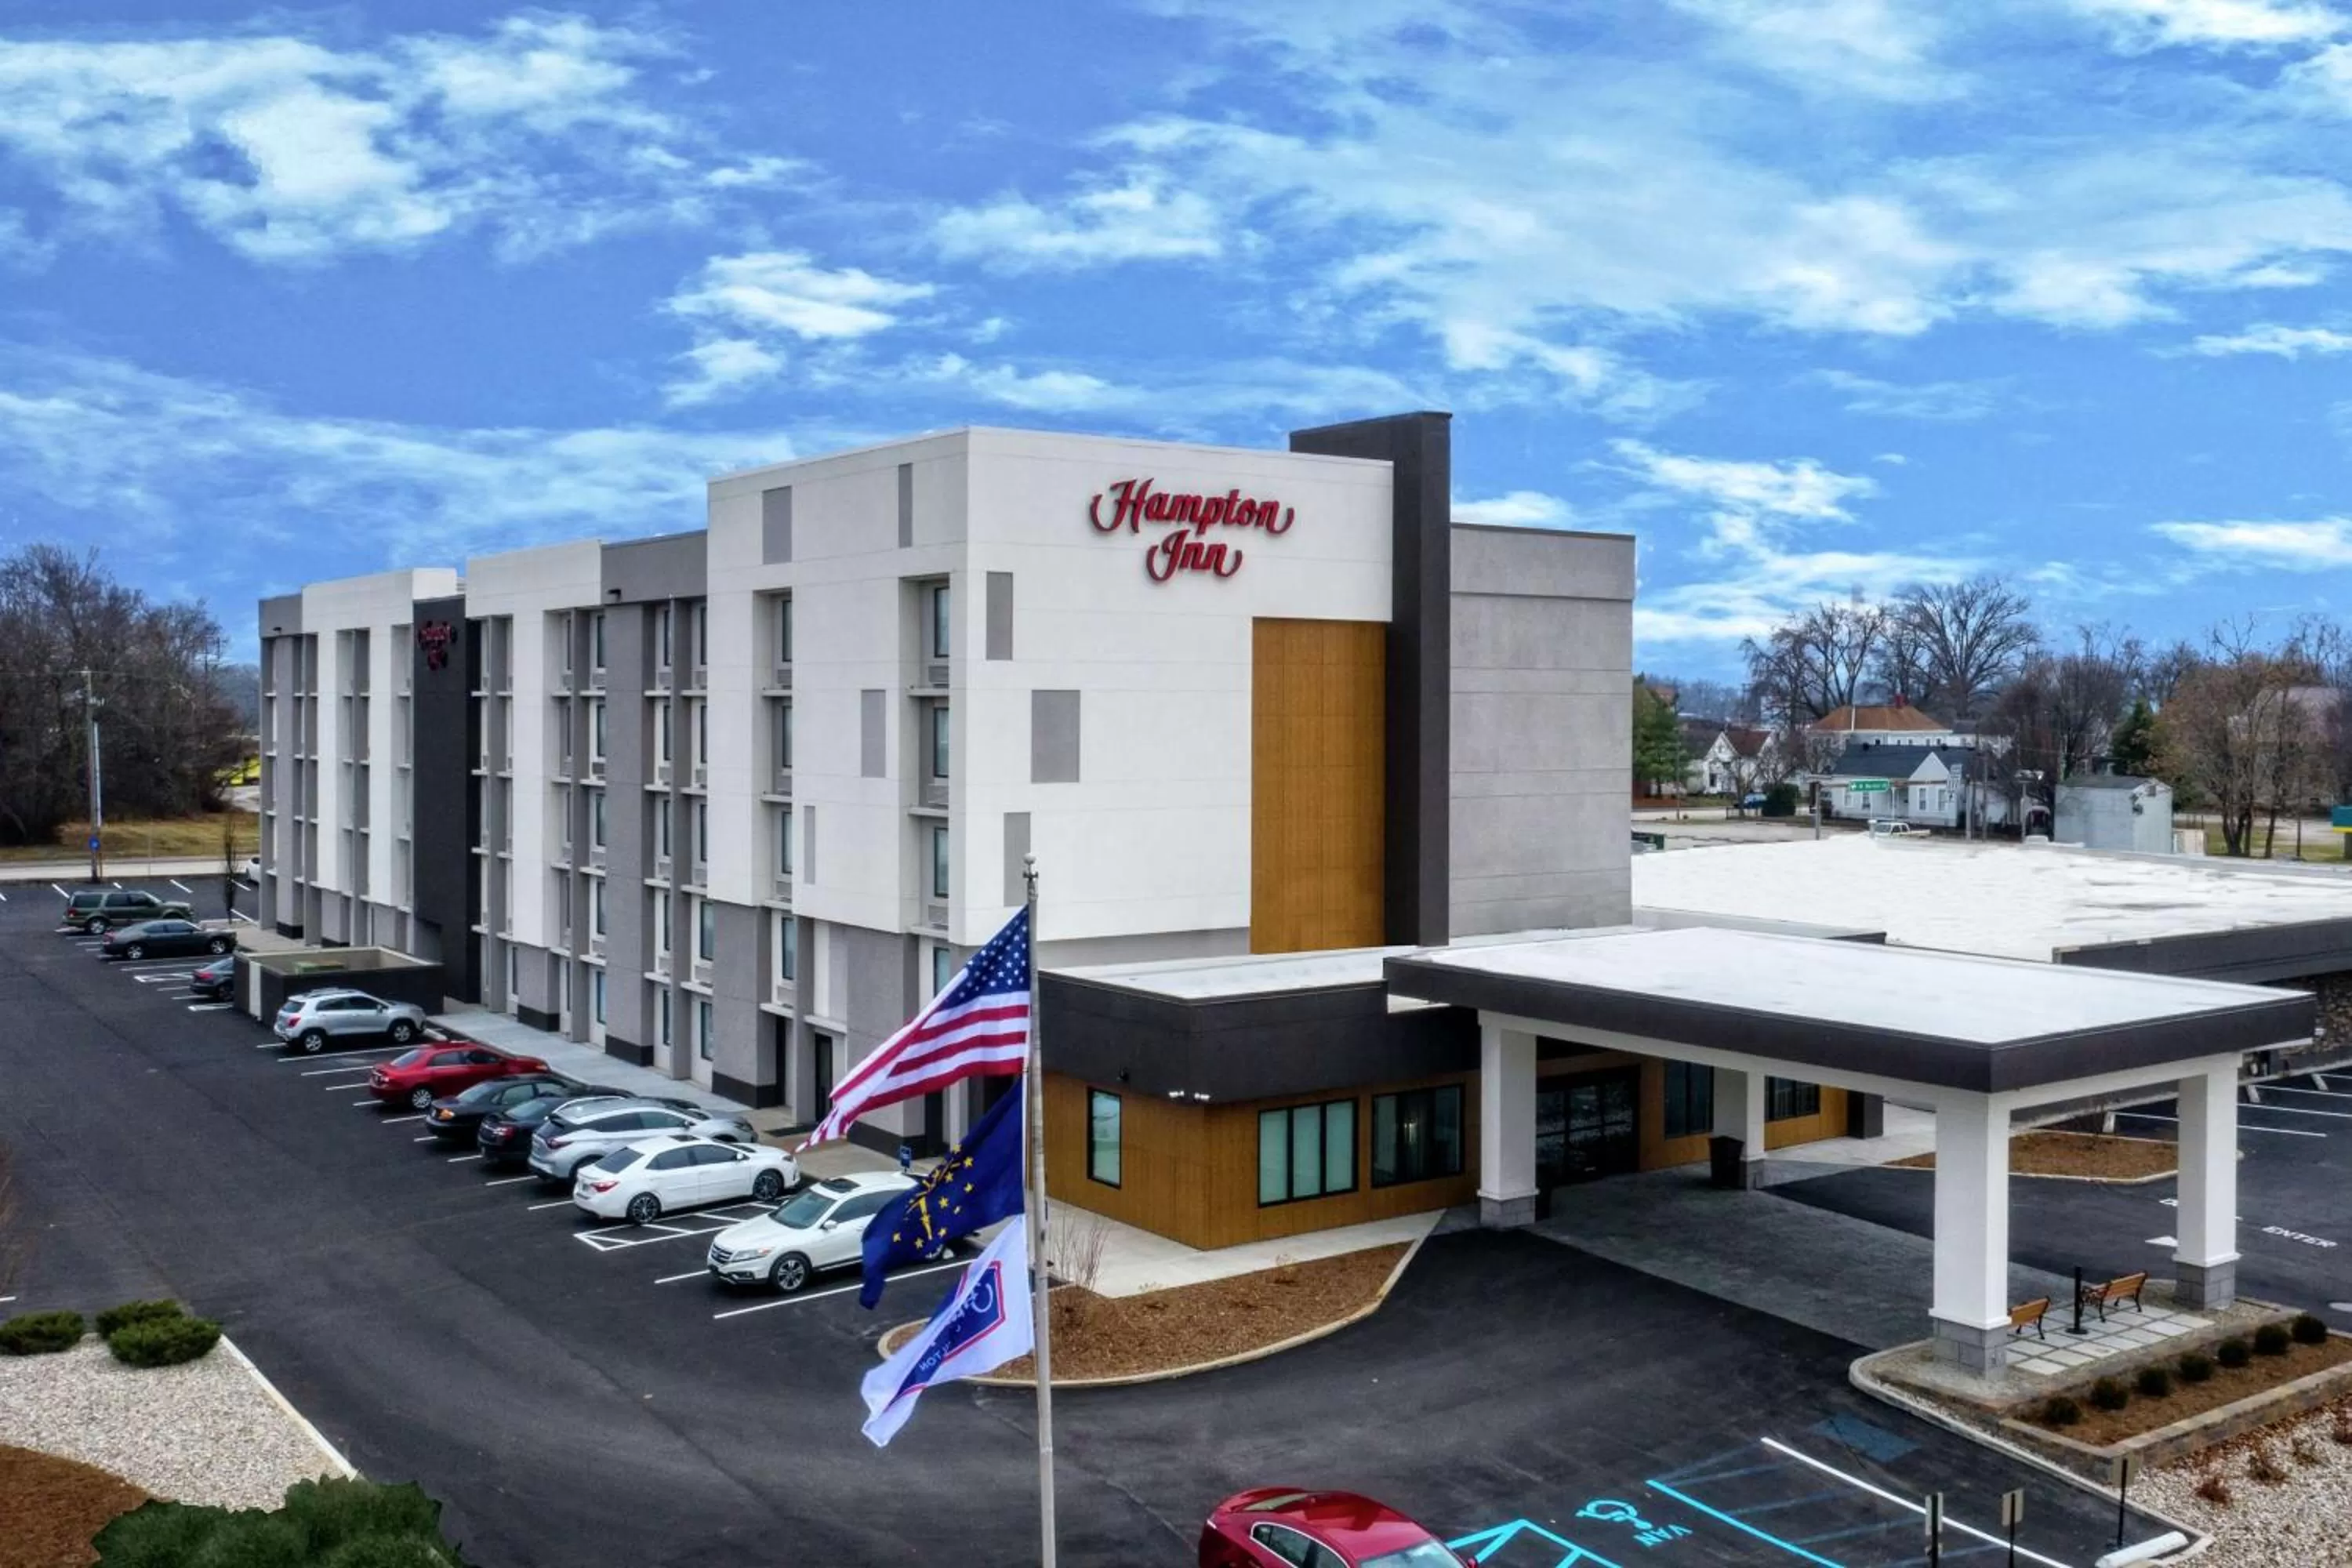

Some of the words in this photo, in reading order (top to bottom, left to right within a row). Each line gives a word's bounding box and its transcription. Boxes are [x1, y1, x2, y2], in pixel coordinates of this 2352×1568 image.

[1090, 477, 1295, 535] Hampton
[1146, 529, 1243, 582] Inn
[2262, 1225, 2337, 1247] ENTER
[1634, 1523, 1693, 1548] VAN
